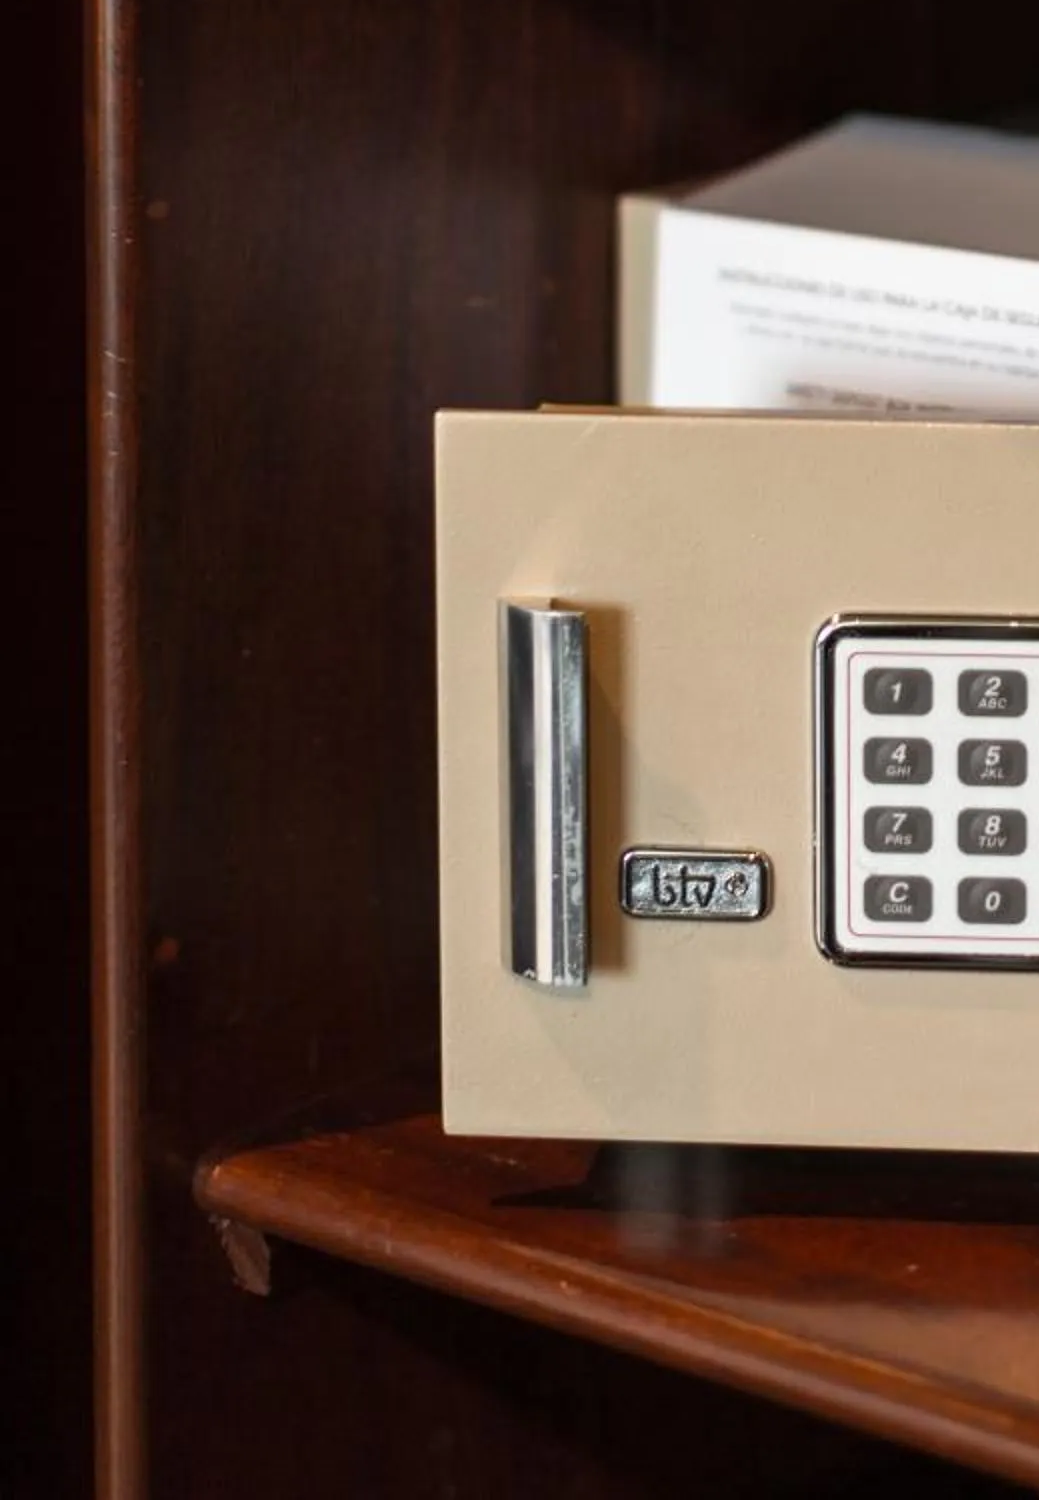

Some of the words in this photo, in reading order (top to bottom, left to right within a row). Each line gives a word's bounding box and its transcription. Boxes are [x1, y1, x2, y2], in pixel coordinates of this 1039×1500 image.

[891, 682, 902, 703] 1
[983, 676, 1002, 697] 2
[977, 697, 1007, 710] ABC
[891, 742, 907, 764] 4
[984, 745, 1002, 767] 5
[885, 764, 911, 777] GHI
[979, 767, 1005, 780] JKL
[892, 812, 907, 833] 7
[984, 815, 1002, 836] 8
[884, 833, 913, 846] PRS
[978, 835, 1007, 849] TUV
[652, 863, 717, 909] btv
[889, 881, 910, 904] C
[882, 902, 914, 915] CODE
